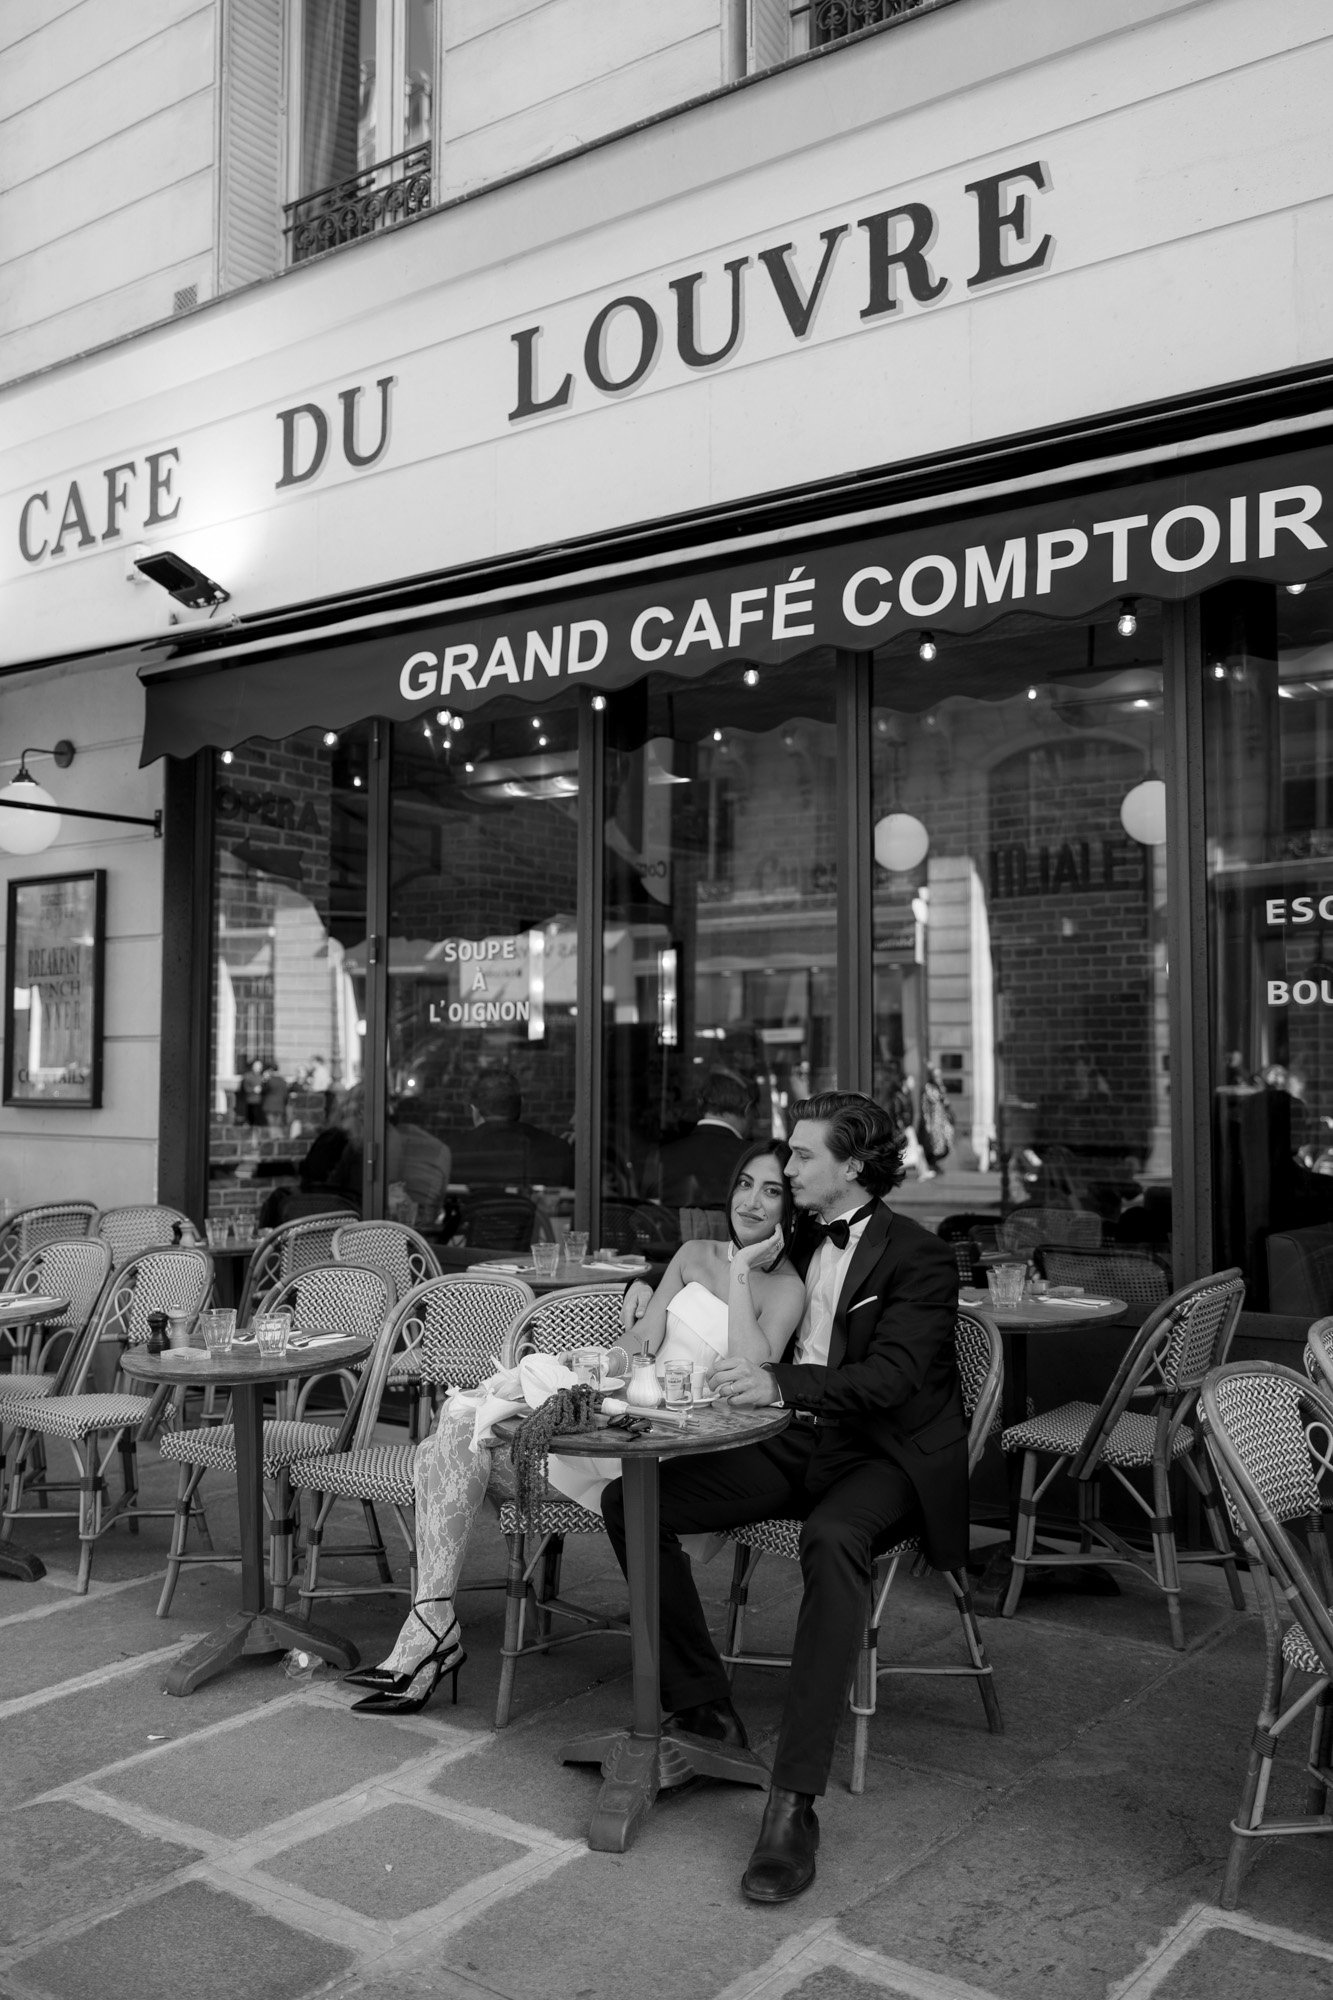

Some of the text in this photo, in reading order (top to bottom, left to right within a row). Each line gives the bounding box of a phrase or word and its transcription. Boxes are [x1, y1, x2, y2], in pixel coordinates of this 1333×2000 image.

[18, 160, 1055, 563] CAFE DU LOUVRE
[399, 484, 1328, 701] GRAND CAFÉ COMPTOIR
[444, 940, 516, 962] SOUPE
[28, 980, 81, 998] UNCH
[472, 966, 487, 992] À
[429, 1000, 531, 1023] L'OIGNON
